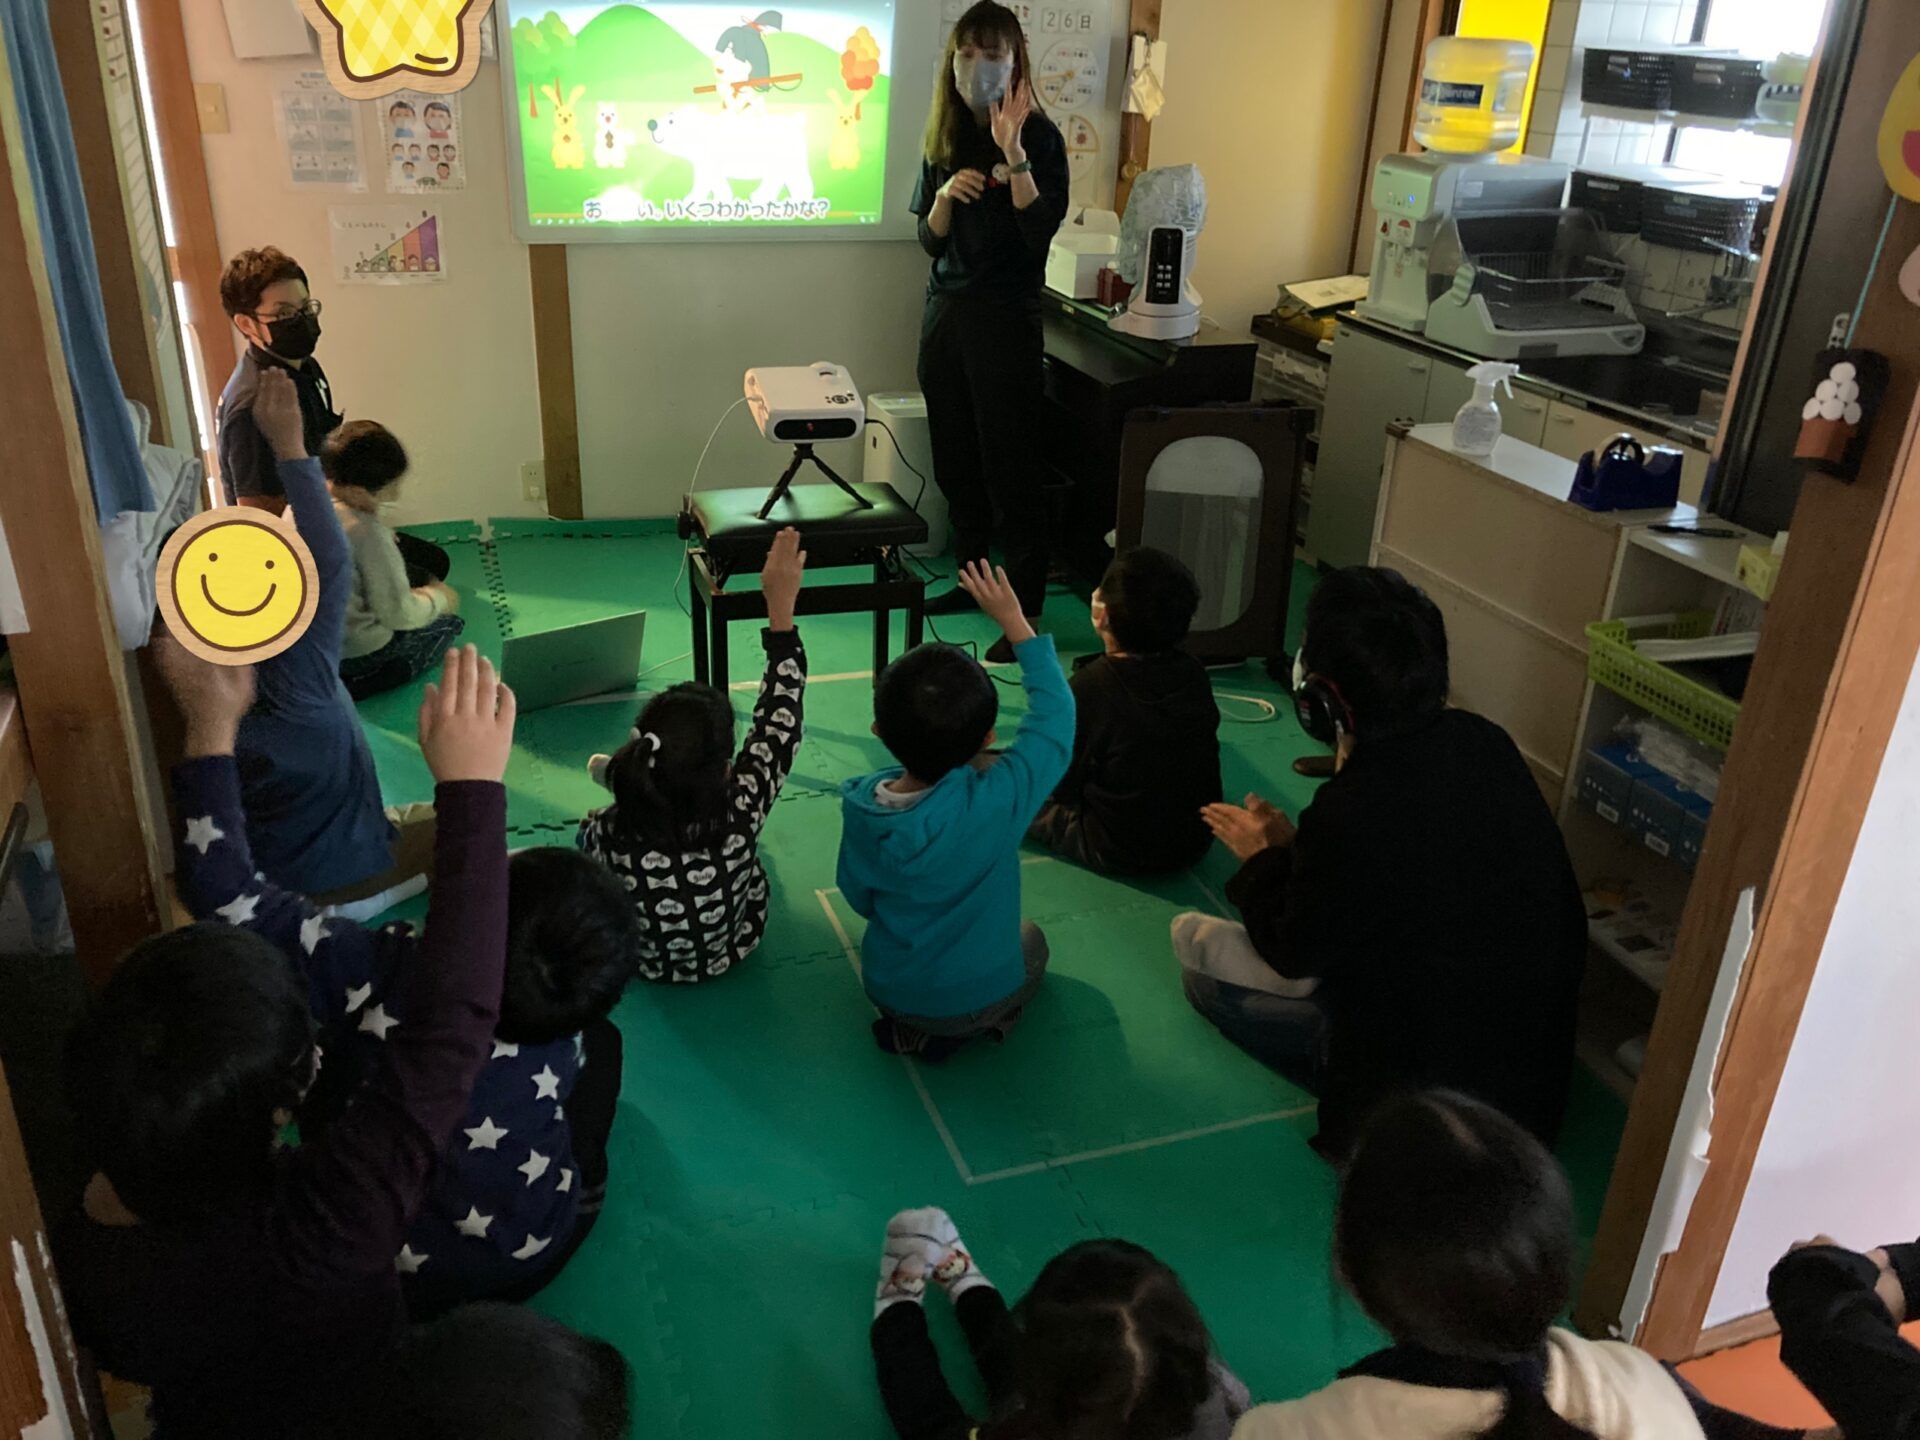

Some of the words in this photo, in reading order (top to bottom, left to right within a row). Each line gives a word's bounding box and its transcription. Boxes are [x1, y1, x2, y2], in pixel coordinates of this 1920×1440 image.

[1047, 11, 1091, 30] 26日
[585, 200, 829, 219] おい。いくつわかったかな？
